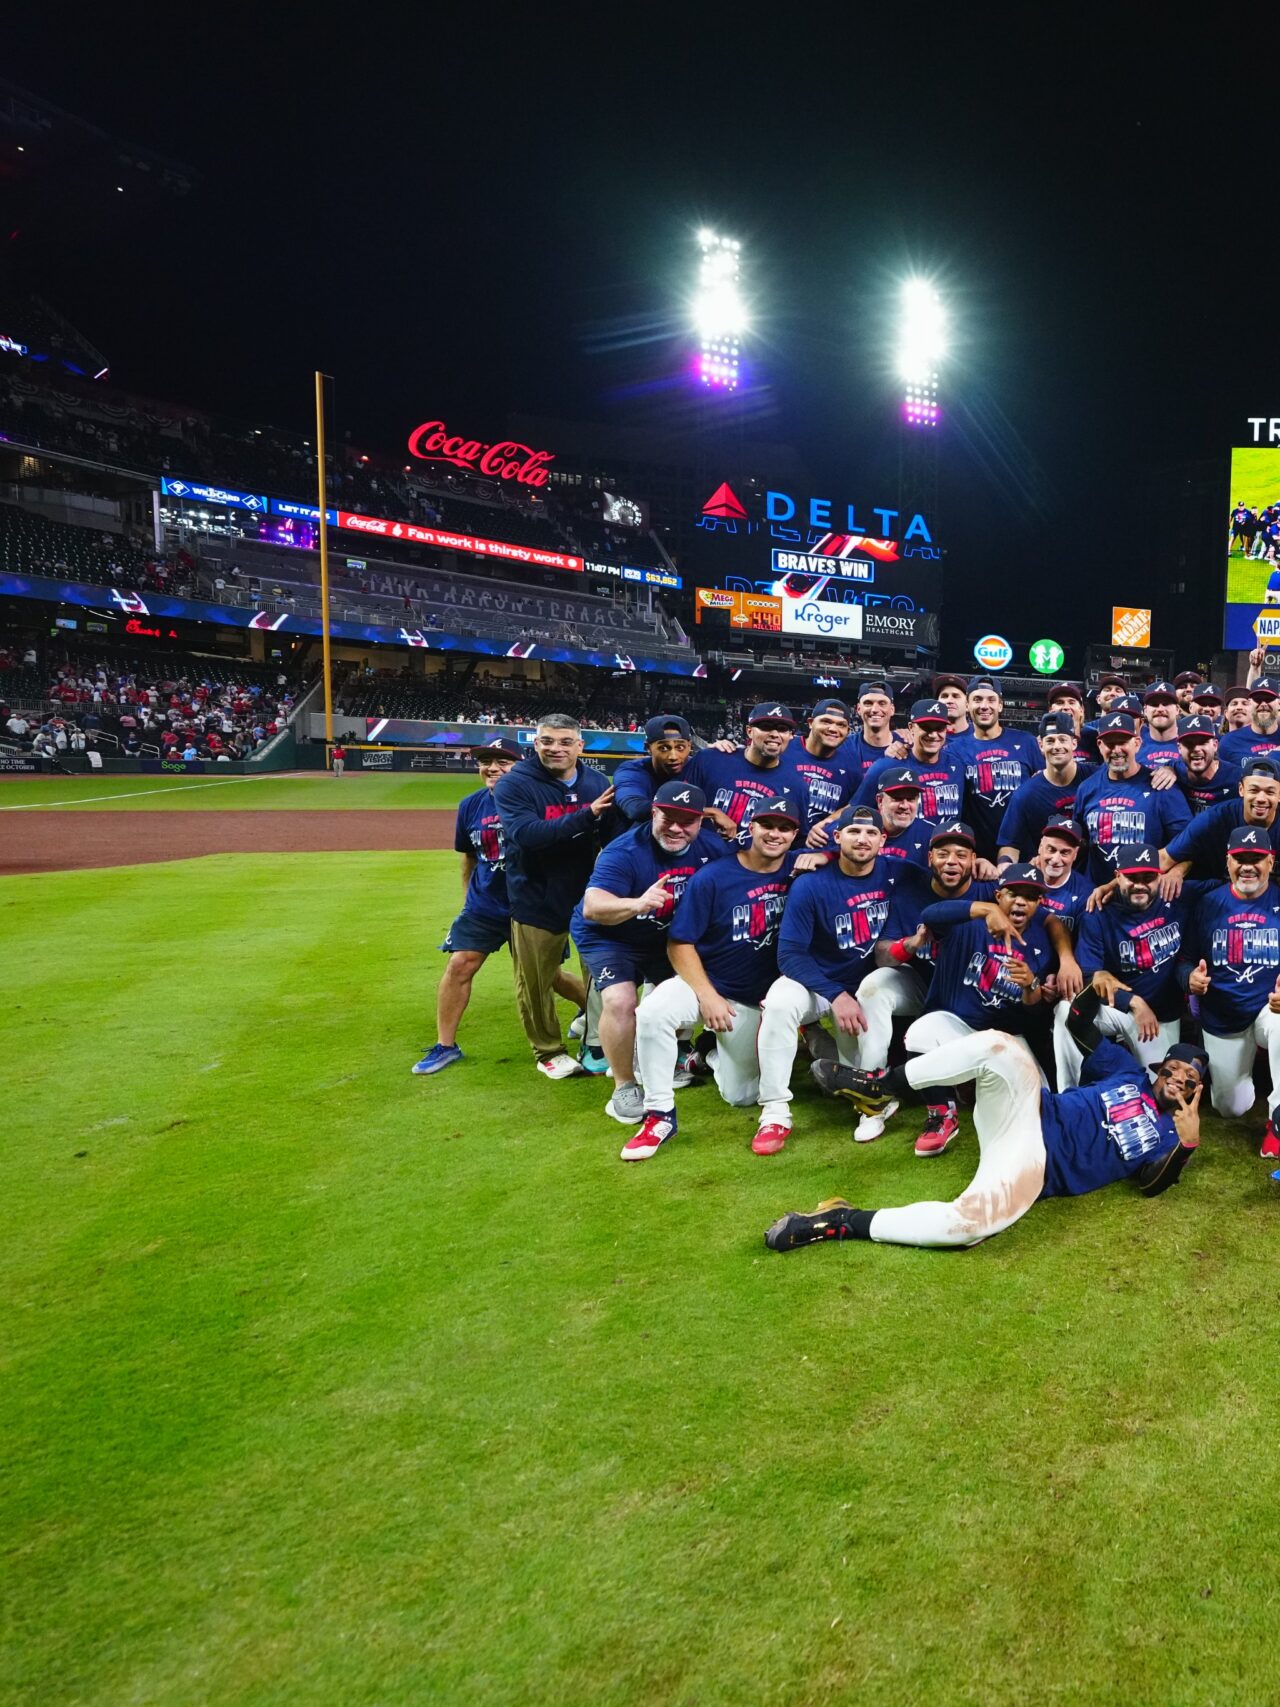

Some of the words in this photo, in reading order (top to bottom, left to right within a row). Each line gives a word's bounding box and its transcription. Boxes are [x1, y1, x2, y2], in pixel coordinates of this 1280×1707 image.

[408, 421, 555, 487] Coca-Cola
[767, 491, 932, 542] DELTA
[407, 528, 434, 541] Fan
[437, 534, 472, 549] work
[475, 540, 486, 551] is
[489, 541, 531, 562] thirsty
[533, 551, 564, 566] work
[585, 562, 606, 573] 11:07
[608, 566, 620, 576] PM
[777, 553, 836, 574] BRAVES
[839, 561, 868, 578] WIN
[752, 612, 781, 626] 440
[795, 602, 850, 633] Kroger
[866, 614, 916, 630] EMORY
[1113, 609, 1150, 645] HOME
[866, 627, 914, 636] HEALTHCARE
[977, 646, 1008, 659] Gulf
